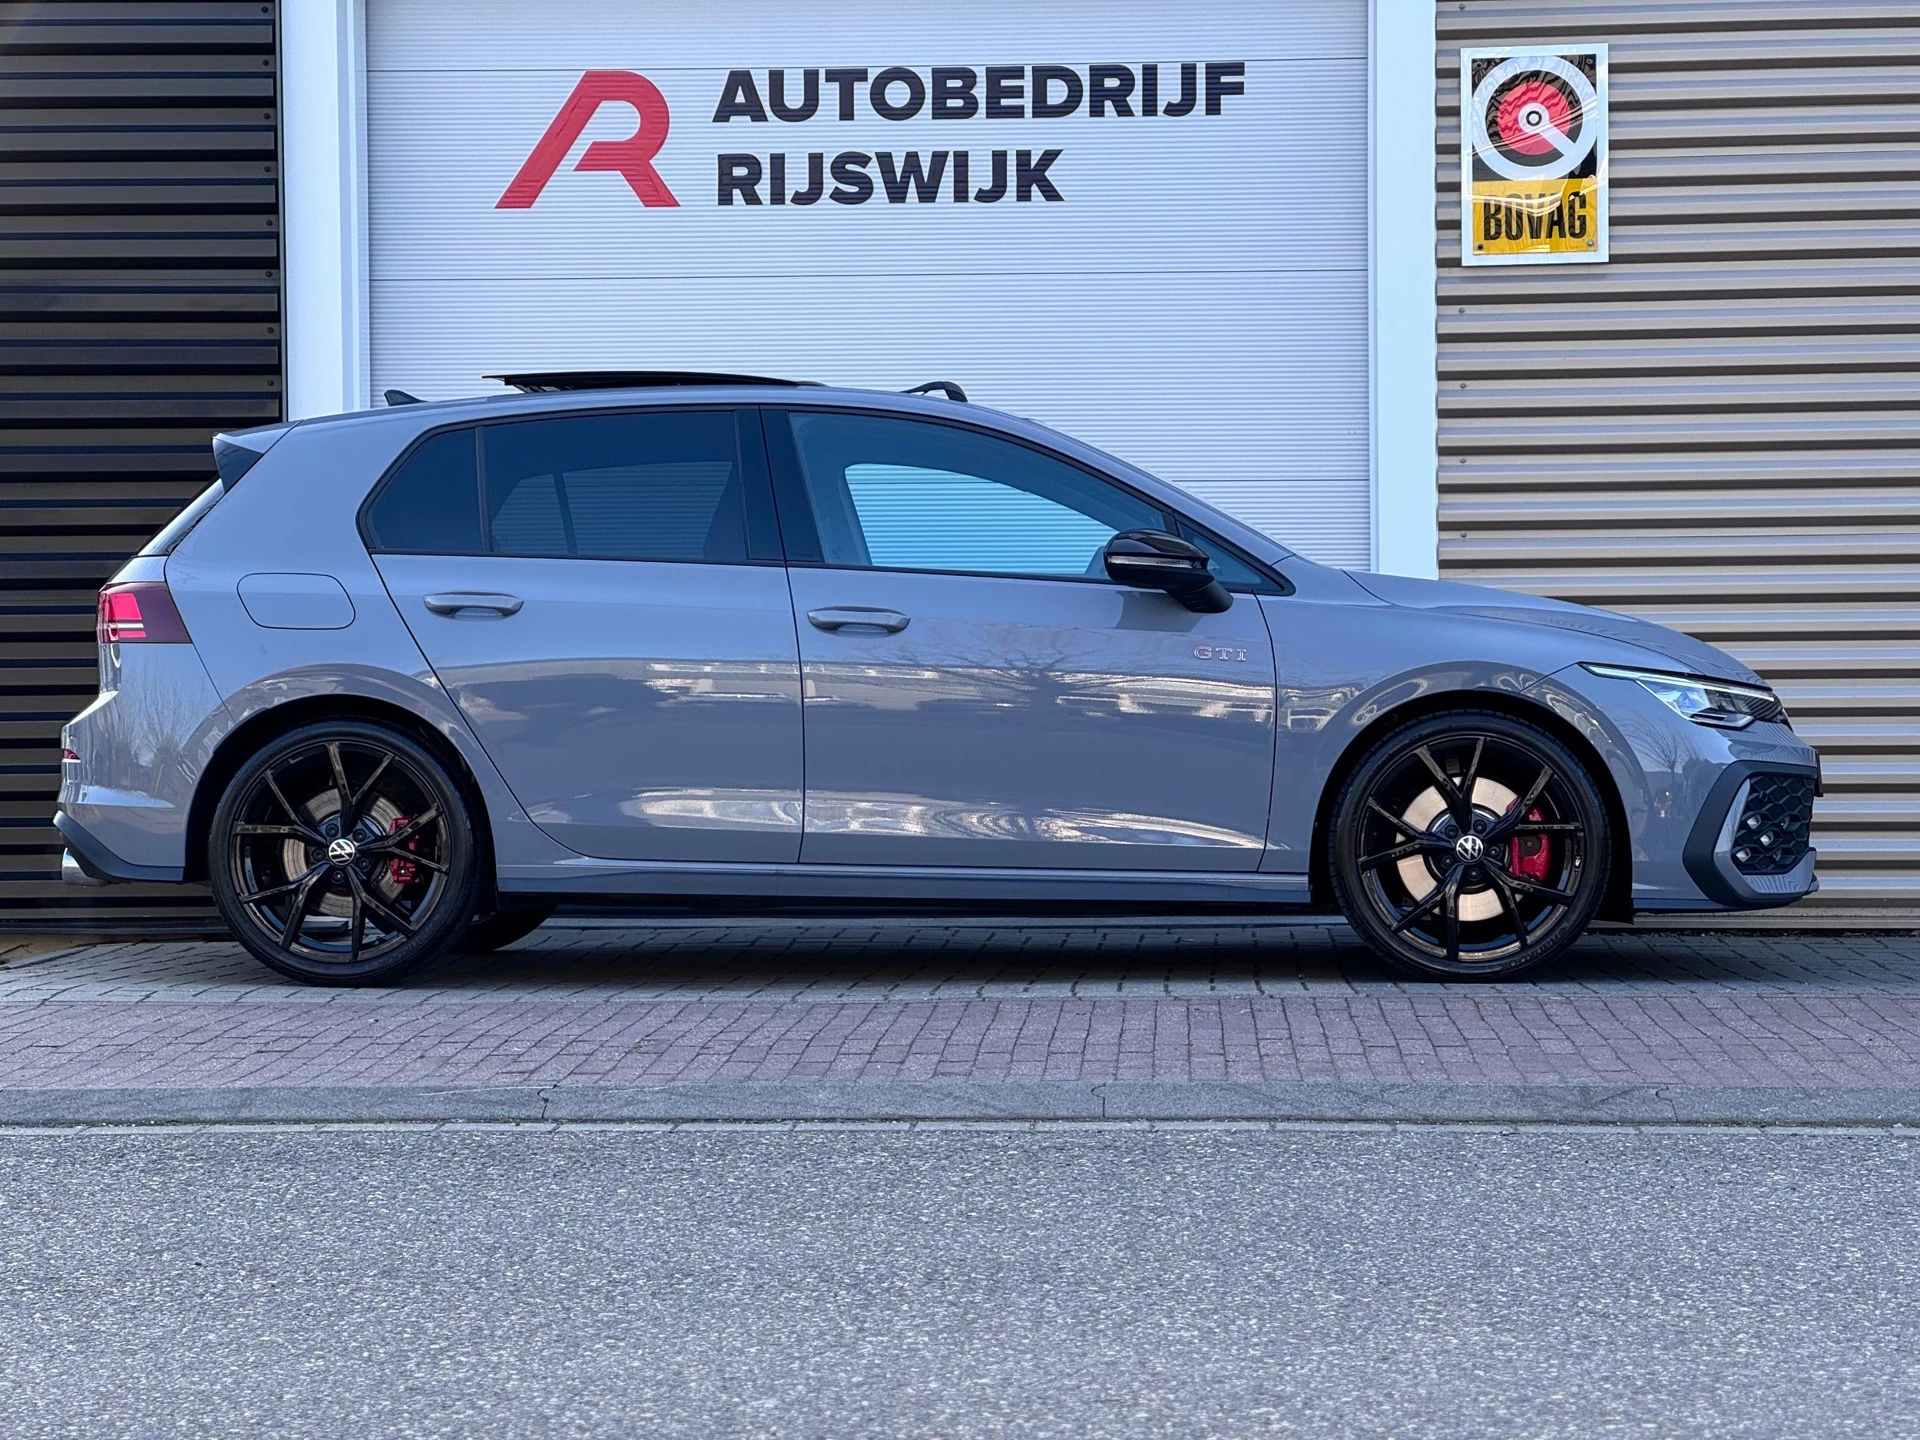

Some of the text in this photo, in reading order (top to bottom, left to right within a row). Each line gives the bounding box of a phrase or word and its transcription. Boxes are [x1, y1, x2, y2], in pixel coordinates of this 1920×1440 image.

[713, 61, 1245, 122] AUTOBEDRIJF
[717, 149, 1064, 206] RIJSWIJK
[1484, 191, 1587, 241] BOVAG
[1194, 645, 1247, 661] GTI
